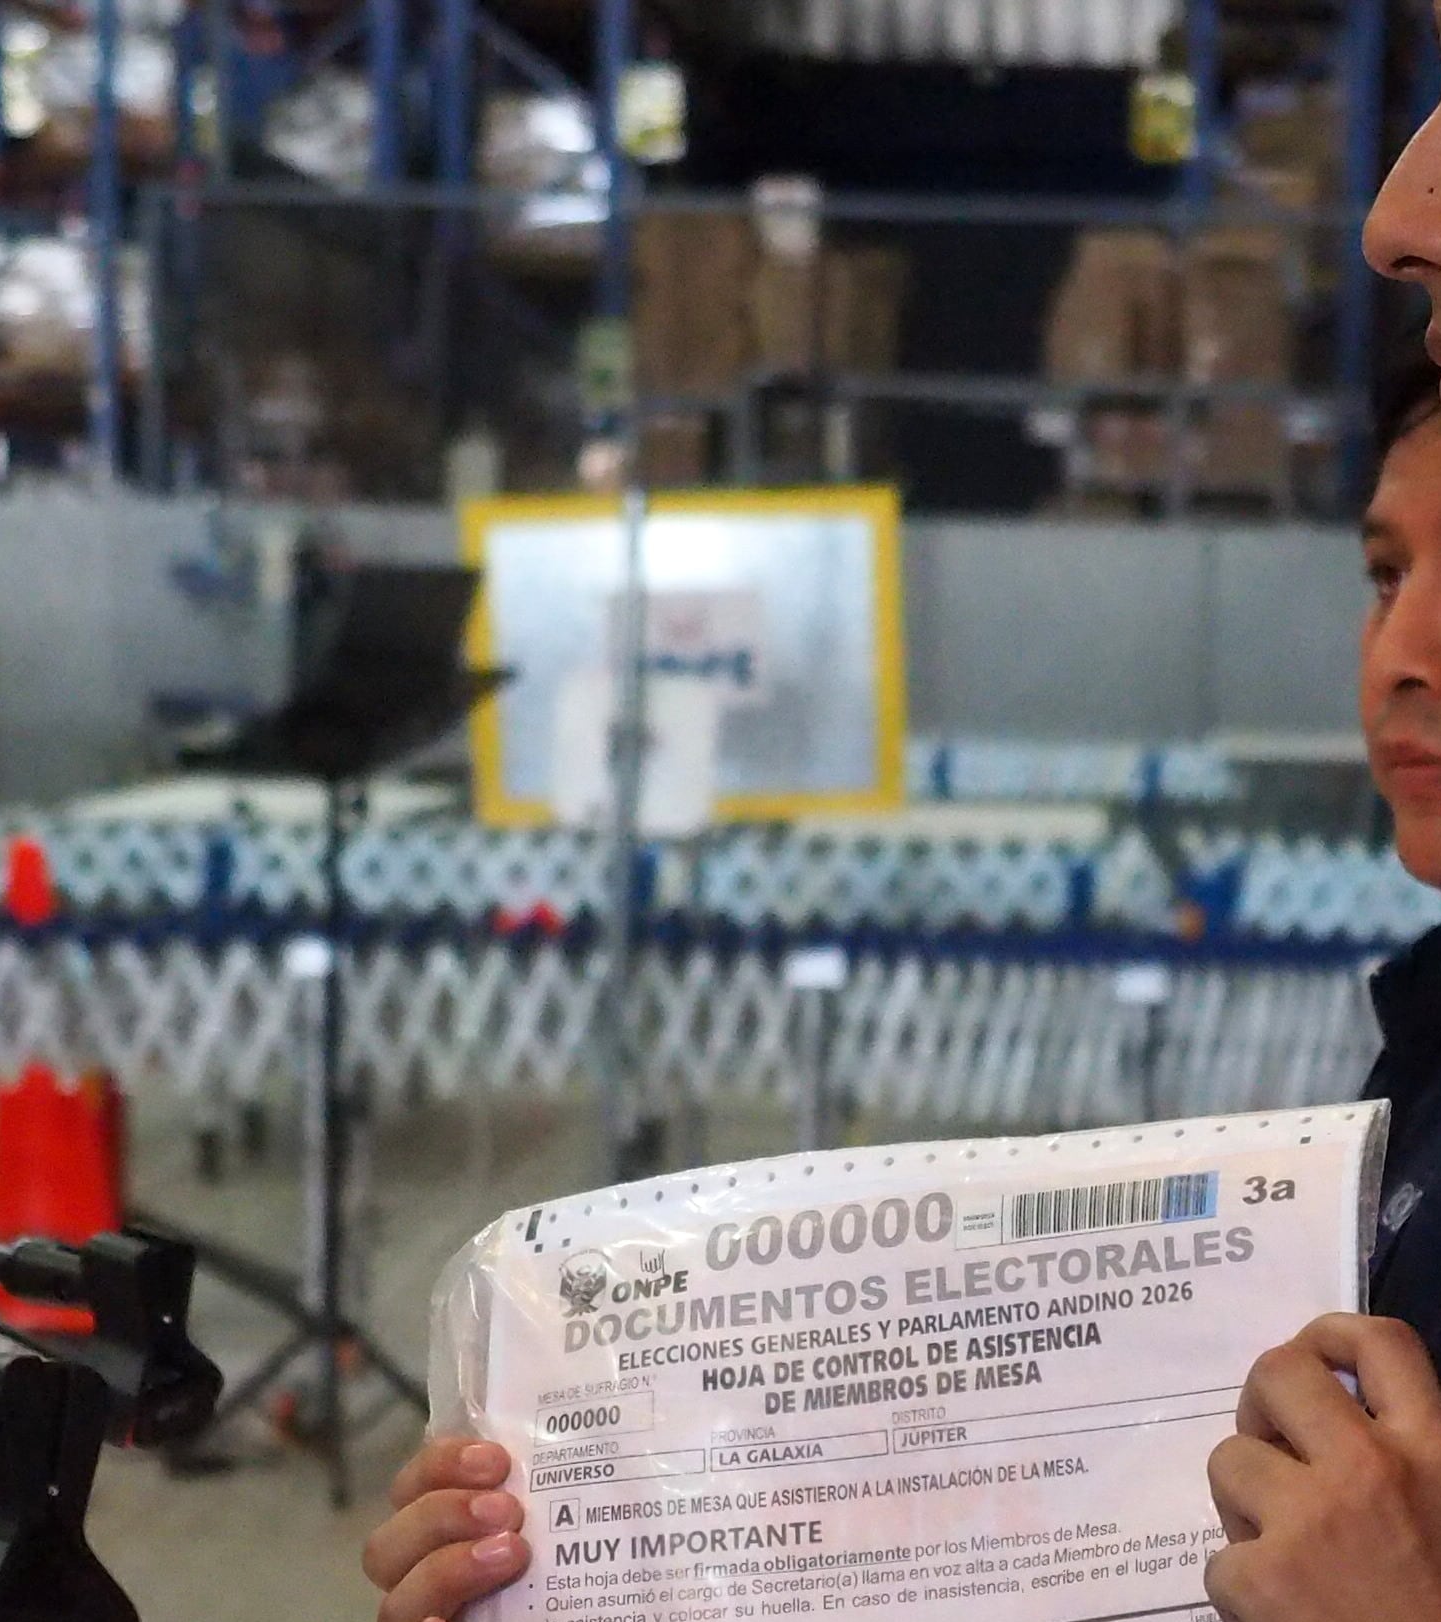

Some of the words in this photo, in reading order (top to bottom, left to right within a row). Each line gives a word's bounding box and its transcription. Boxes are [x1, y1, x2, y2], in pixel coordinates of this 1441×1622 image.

[1242, 1175, 1296, 1206] 3a
[705, 1191, 954, 1271] 000000
[564, 1276, 889, 1354] DOCUMENTOS
[904, 1226, 1255, 1307] ELECTORALES
[611, 1270, 689, 1304] ONPE
[618, 1337, 744, 1371] ELECCIONES
[751, 1322, 872, 1355] GENERALES
[878, 1319, 894, 1340] Y
[898, 1300, 1040, 1336] PARLAMENTO
[1047, 1288, 1134, 1317] ANDINO
[1141, 1280, 1194, 1306] 2026
[702, 1364, 765, 1392] HOJA
[774, 1359, 804, 1384] DE
[813, 1343, 919, 1380] CONTROL
[927, 1340, 958, 1365] DE
[966, 1320, 1103, 1361] ASISTENCIA
[764, 1389, 797, 1416] DE
[803, 1373, 928, 1413] MIEMBROS
[936, 1369, 967, 1394] DE
[974, 1359, 1043, 1392] MESA
[546, 1405, 621, 1435] 000000
[710, 1427, 776, 1443] PROVINCIA
[891, 1406, 946, 1425] DISTRITO
[532, 1441, 620, 1466] DEPARTAMENTO
[718, 1450, 742, 1466] LA
[746, 1442, 823, 1464] GALAXIA
[901, 1426, 968, 1447] JUPITER
[536, 1463, 615, 1487] UNIVERSO
[585, 1498, 663, 1525] MIEMBROS
[667, 1498, 686, 1516] DE
[690, 1493, 733, 1514] MESA
[736, 1490, 768, 1510] QUE
[771, 1482, 859, 1507] ASISTIERON
[861, 1480, 873, 1498] A
[875, 1478, 894, 1497] LA
[897, 1465, 993, 1495] INSTALACIÓN
[996, 1463, 1017, 1482] DE
[1021, 1461, 1040, 1479] LA
[1044, 1457, 1090, 1478] MESA.
[554, 1504, 575, 1528] A
[545, 1574, 581, 1592] Esta
[584, 1571, 619, 1592] hoja
[621, 1568, 662, 1586] debe
[693, 1558, 760, 1580] firmada
[763, 1547, 910, 1575] obligatoriamente
[915, 1542, 941, 1560] por
[944, 1538, 967, 1555] los
[970, 1528, 1050, 1551] Miembros
[1053, 1526, 1073, 1543] de
[1076, 1519, 1122, 1541] Mesa.
[555, 1537, 621, 1567] MUY
[630, 1520, 824, 1560] IMPORTANTE
[545, 1593, 595, 1614] Quien
[596, 1589, 656, 1610] asumió
[659, 1584, 675, 1602] el
[677, 1585, 723, 1604] cargo
[726, 1579, 748, 1598] de
[751, 1571, 859, 1596] Secretario(a)
[861, 1566, 906, 1585] llama
[909, 1565, 930, 1580] en
[933, 1562, 962, 1578] voz
[965, 1558, 997, 1576] alta
[999, 1558, 1009, 1572] a
[1013, 1551, 1051, 1570] cada
[1054, 1541, 1120, 1566] Miembro
[1122, 1536, 1142, 1555] de
[1145, 1530, 1187, 1551] Mesa
[1189, 1530, 1200, 1547] y
[734, 1602, 755, 1619] su
[760, 1597, 815, 1617] huella.
[822, 1593, 846, 1611] En
[851, 1590, 891, 1609] caso
[896, 1586, 918, 1604] de
[924, 1578, 1026, 1602] inasistencia,
[1030, 1568, 1085, 1590] escribe
[1090, 1566, 1110, 1581] en
[1114, 1559, 1129, 1578] el
[1134, 1554, 1174, 1577] lugar
[1178, 1548, 1199, 1567] de
